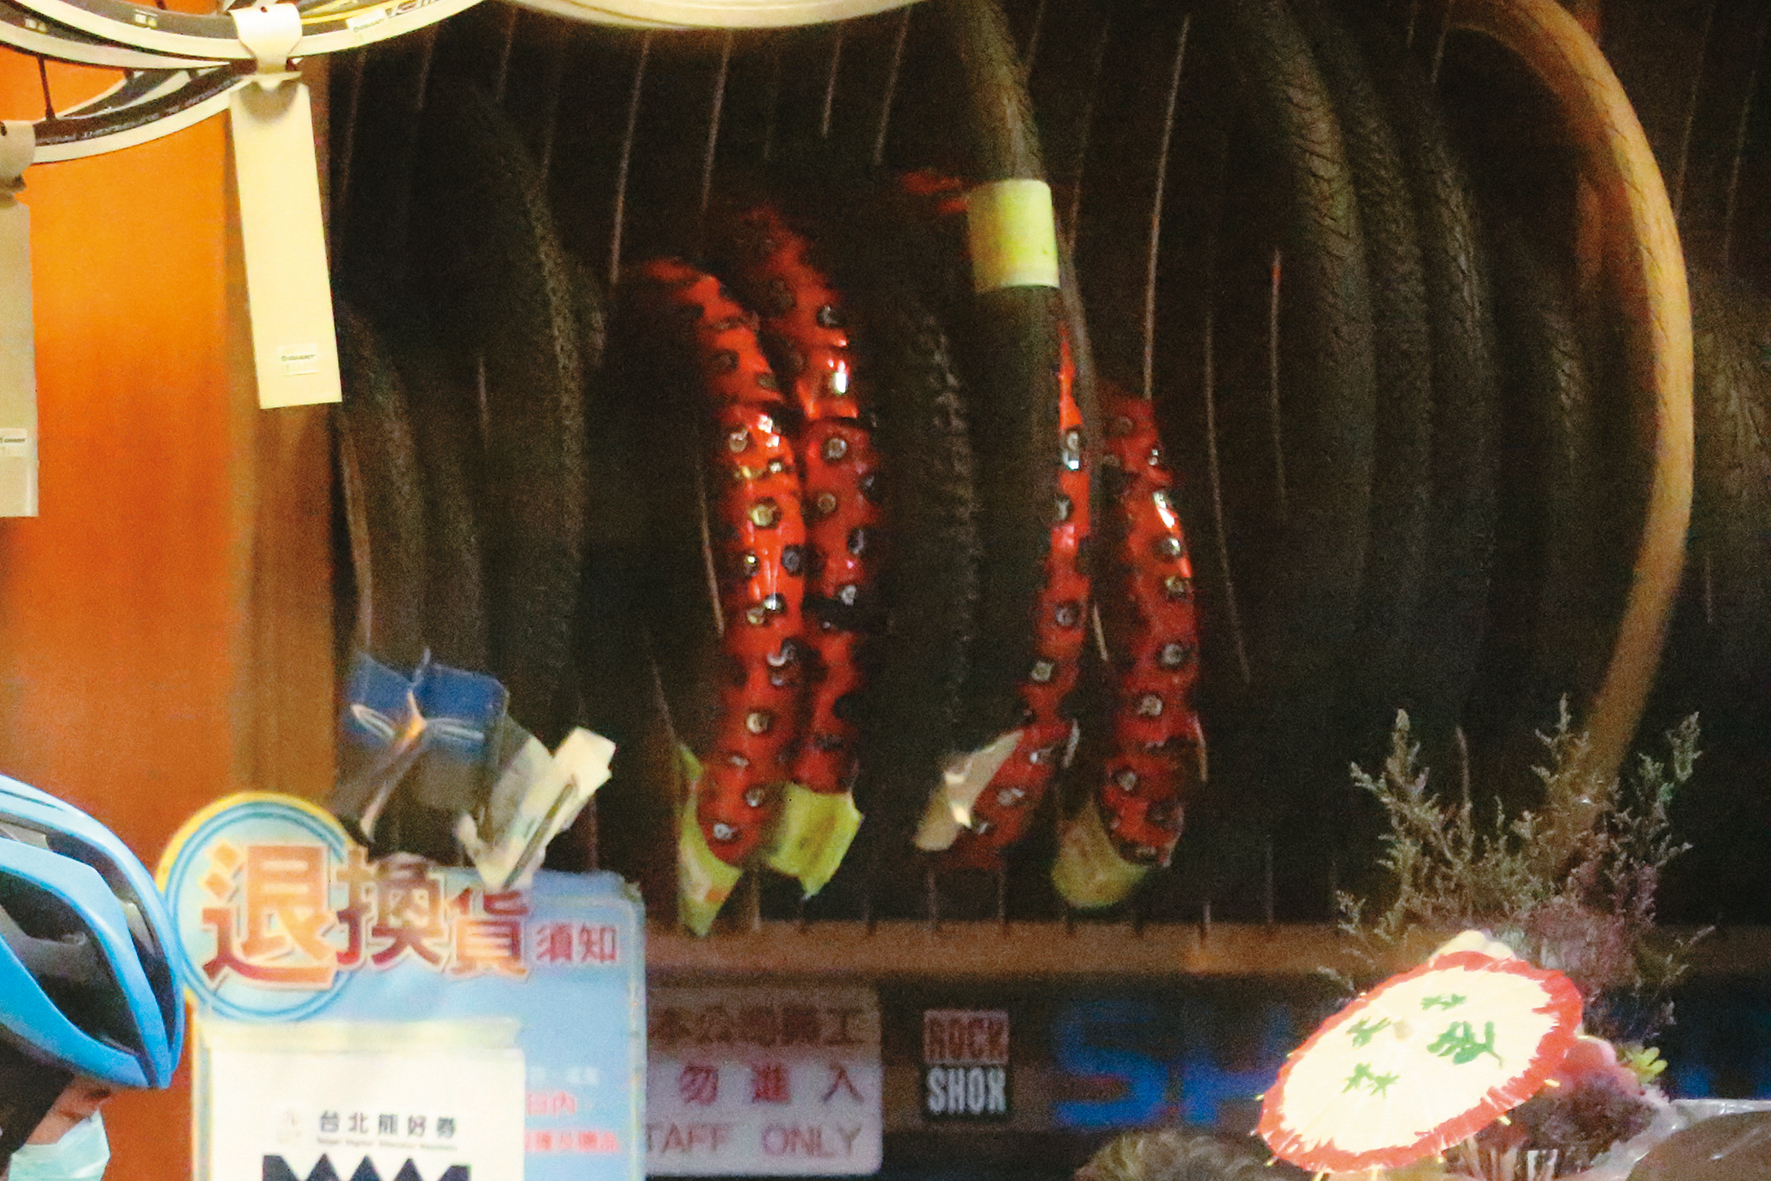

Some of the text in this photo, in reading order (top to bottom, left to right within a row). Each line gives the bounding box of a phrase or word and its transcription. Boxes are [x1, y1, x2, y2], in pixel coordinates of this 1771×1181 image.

[928, 1018, 1006, 1059] ROCK
[928, 1067, 1006, 1114] SHOX
[647, 1122, 863, 1157] TAFF ONLY
